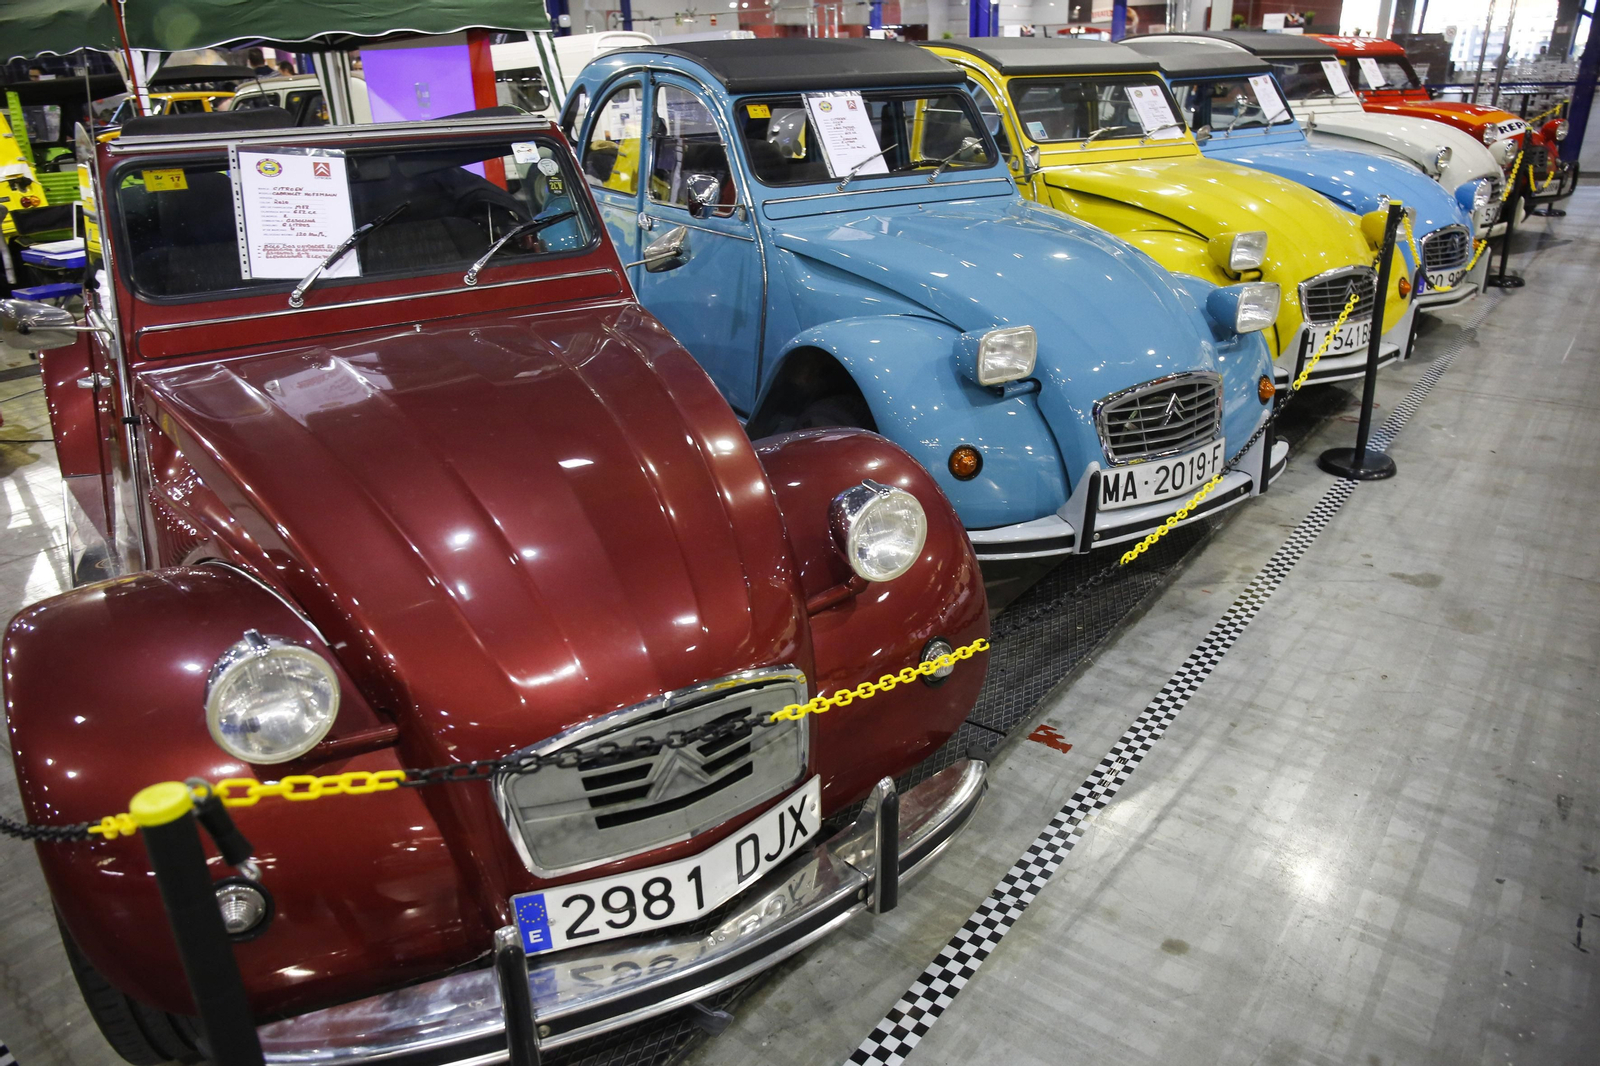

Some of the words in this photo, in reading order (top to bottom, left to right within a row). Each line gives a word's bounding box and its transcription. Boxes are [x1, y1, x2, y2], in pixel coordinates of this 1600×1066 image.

[561, 865, 705, 941] 2981
[735, 793, 809, 885] DJX
[528, 929, 544, 945] E
